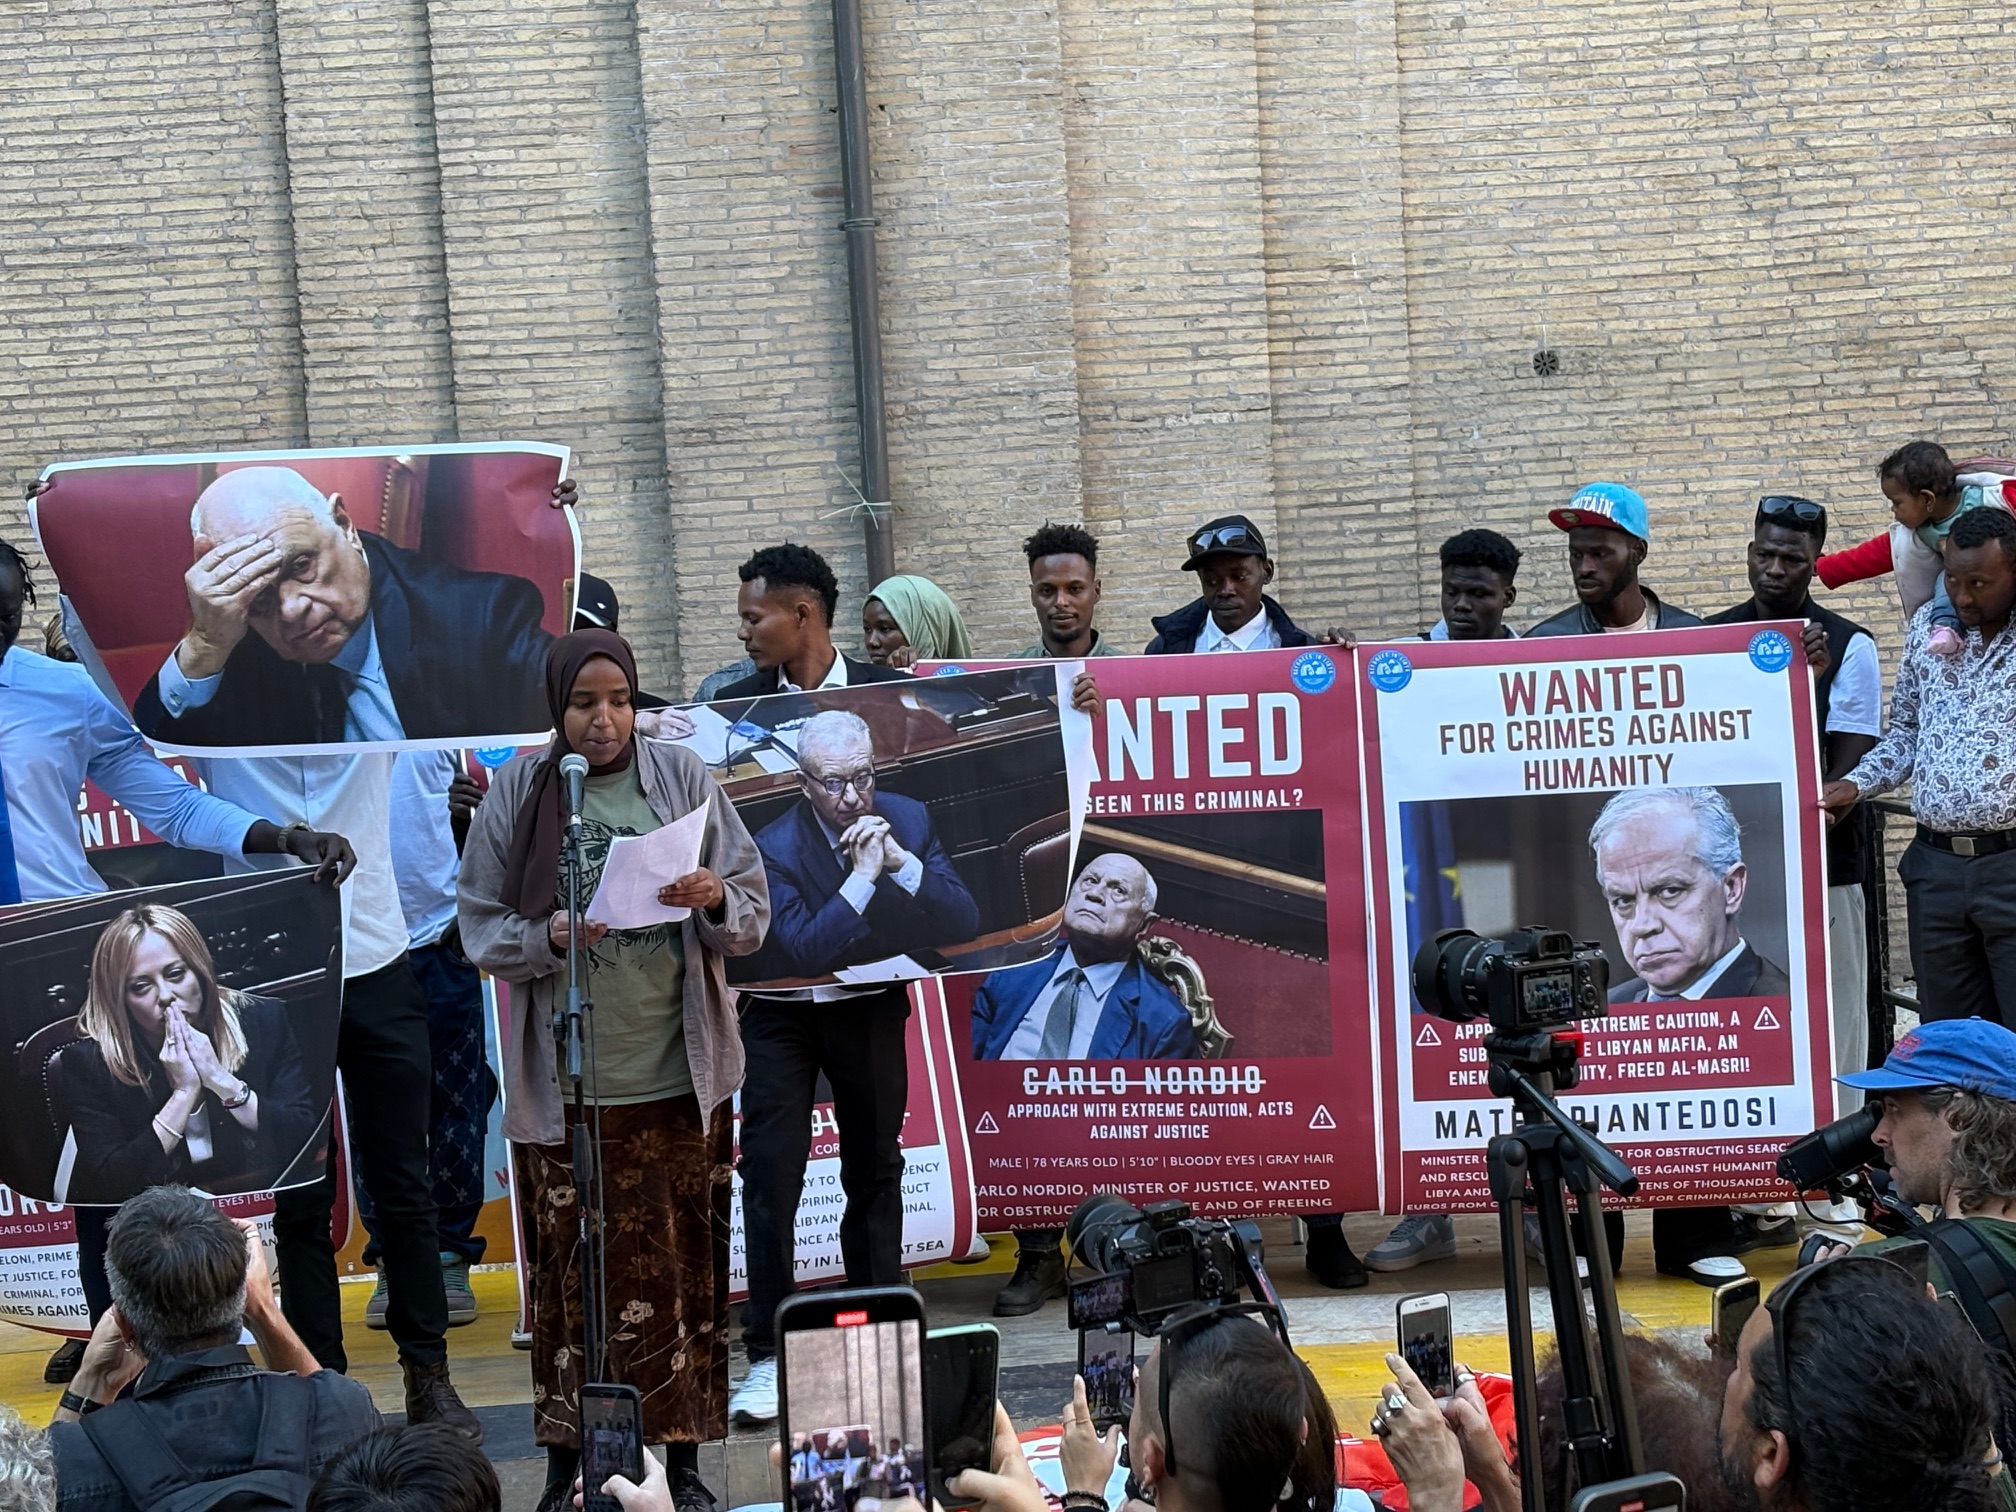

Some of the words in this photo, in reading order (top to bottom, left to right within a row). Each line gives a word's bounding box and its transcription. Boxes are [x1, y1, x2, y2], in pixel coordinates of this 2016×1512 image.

[1499, 663, 1685, 716] WANTED
[1090, 691, 1303, 782] NTED
[1439, 722, 1495, 755] FOR
[1507, 717, 1615, 751] CRIMES
[1627, 709, 1753, 746] AGAINST
[1524, 753, 1674, 791] HUMANITY
[1142, 793, 1185, 812] THIS
[1195, 788, 1304, 809] CRIMINAL?
[1581, 1014, 1651, 1034] EXTREME
[1656, 1011, 1724, 1030] CAUTION,
[1730, 1010, 1741, 1026] A
[1459, 1047, 1488, 1063] SUB
[1597, 1039, 1652, 1057] LIBYAN
[1658, 1035, 1712, 1053] MAFIA,
[1717, 1034, 1738, 1050] AN
[1023, 1066, 1127, 1096] CARLO
[1144, 1065, 1263, 1095] NORDIO
[1449, 1070, 1489, 1086] ENEM
[1580, 1063, 1612, 1081] ITY,
[1617, 1061, 1665, 1079] FREED
[1671, 1056, 1750, 1076] AL-MASRI!
[1007, 1102, 1078, 1119] APPROACH
[1083, 1102, 1115, 1118] WITH
[1122, 1102, 1185, 1118] EXTREME
[1190, 1101, 1253, 1118] CAUTION,
[1258, 1100, 1294, 1116] ACTS
[1090, 1124, 1149, 1140] AGAINST
[1154, 1124, 1210, 1139] JUSTICE
[988, 1156, 1022, 1169] MALE
[1033, 1156, 1047, 1168] 78
[1050, 1156, 1089, 1168] YEARS
[1092, 1156, 1118, 1168] OLD
[1170, 1154, 1222, 1167] BLOODY
[1225, 1153, 1255, 1166] EYES
[1266, 1153, 1300, 1166] GRAY
[1303, 1152, 1335, 1165] HAIR
[1421, 1155, 1479, 1166] MINISTER
[1627, 1148, 1652, 1159] FOR
[1655, 1144, 1744, 1158] OBSTRUCTING
[1747, 1142, 1790, 1154] SEARC
[818, 1174, 836, 1186] TO
[1419, 1173, 1447, 1184] AND
[1450, 1171, 1489, 1182] RESCU
[1654, 1163, 1708, 1175] AGAINST
[1022, 1184, 1088, 1197] NORDIO,
[1092, 1182, 1164, 1197] MINISTER
[1168, 1181, 1189, 1194] OF
[1194, 1180, 1259, 1194] JUSTICE,
[1264, 1178, 1331, 1192] WANTED
[1425, 1187, 1461, 1199] LIBYA
[1464, 1187, 1491, 1198] AND
[1639, 1179, 1670, 1190] TENS
[1673, 1179, 1690, 1189] OF
[1693, 1176, 1771, 1188] THOUSANDS
[24, 1223, 45, 1233] OLD
[218, 1196, 244, 1208] EYES
[253, 1191, 275, 1203] BLO
[797, 1193, 844, 1209] PIRING
[978, 1206, 999, 1218] OR
[1204, 1200, 1238, 1211] AND
[1242, 1199, 1265, 1210] OF
[1268, 1198, 1334, 1209] FREEING
[1406, 1202, 1447, 1212] EUROS
[1451, 1201, 1487, 1210] FROM
[1649, 1193, 1673, 1203] FOR
[1677, 1190, 1789, 1202] CRIMINALISATION
[794, 1212, 838, 1228] LIBYAN
[37, 1251, 73, 1263] PRIME
[815, 1255, 830, 1268] IN
[916, 1239, 944, 1252] SEA
[13, 1270, 59, 1282] JUSTICE,
[3, 1288, 59, 1300] CRIMINAL,
[60, 1286, 83, 1298] FOR
[37, 1303, 89, 1317] AGAINS
